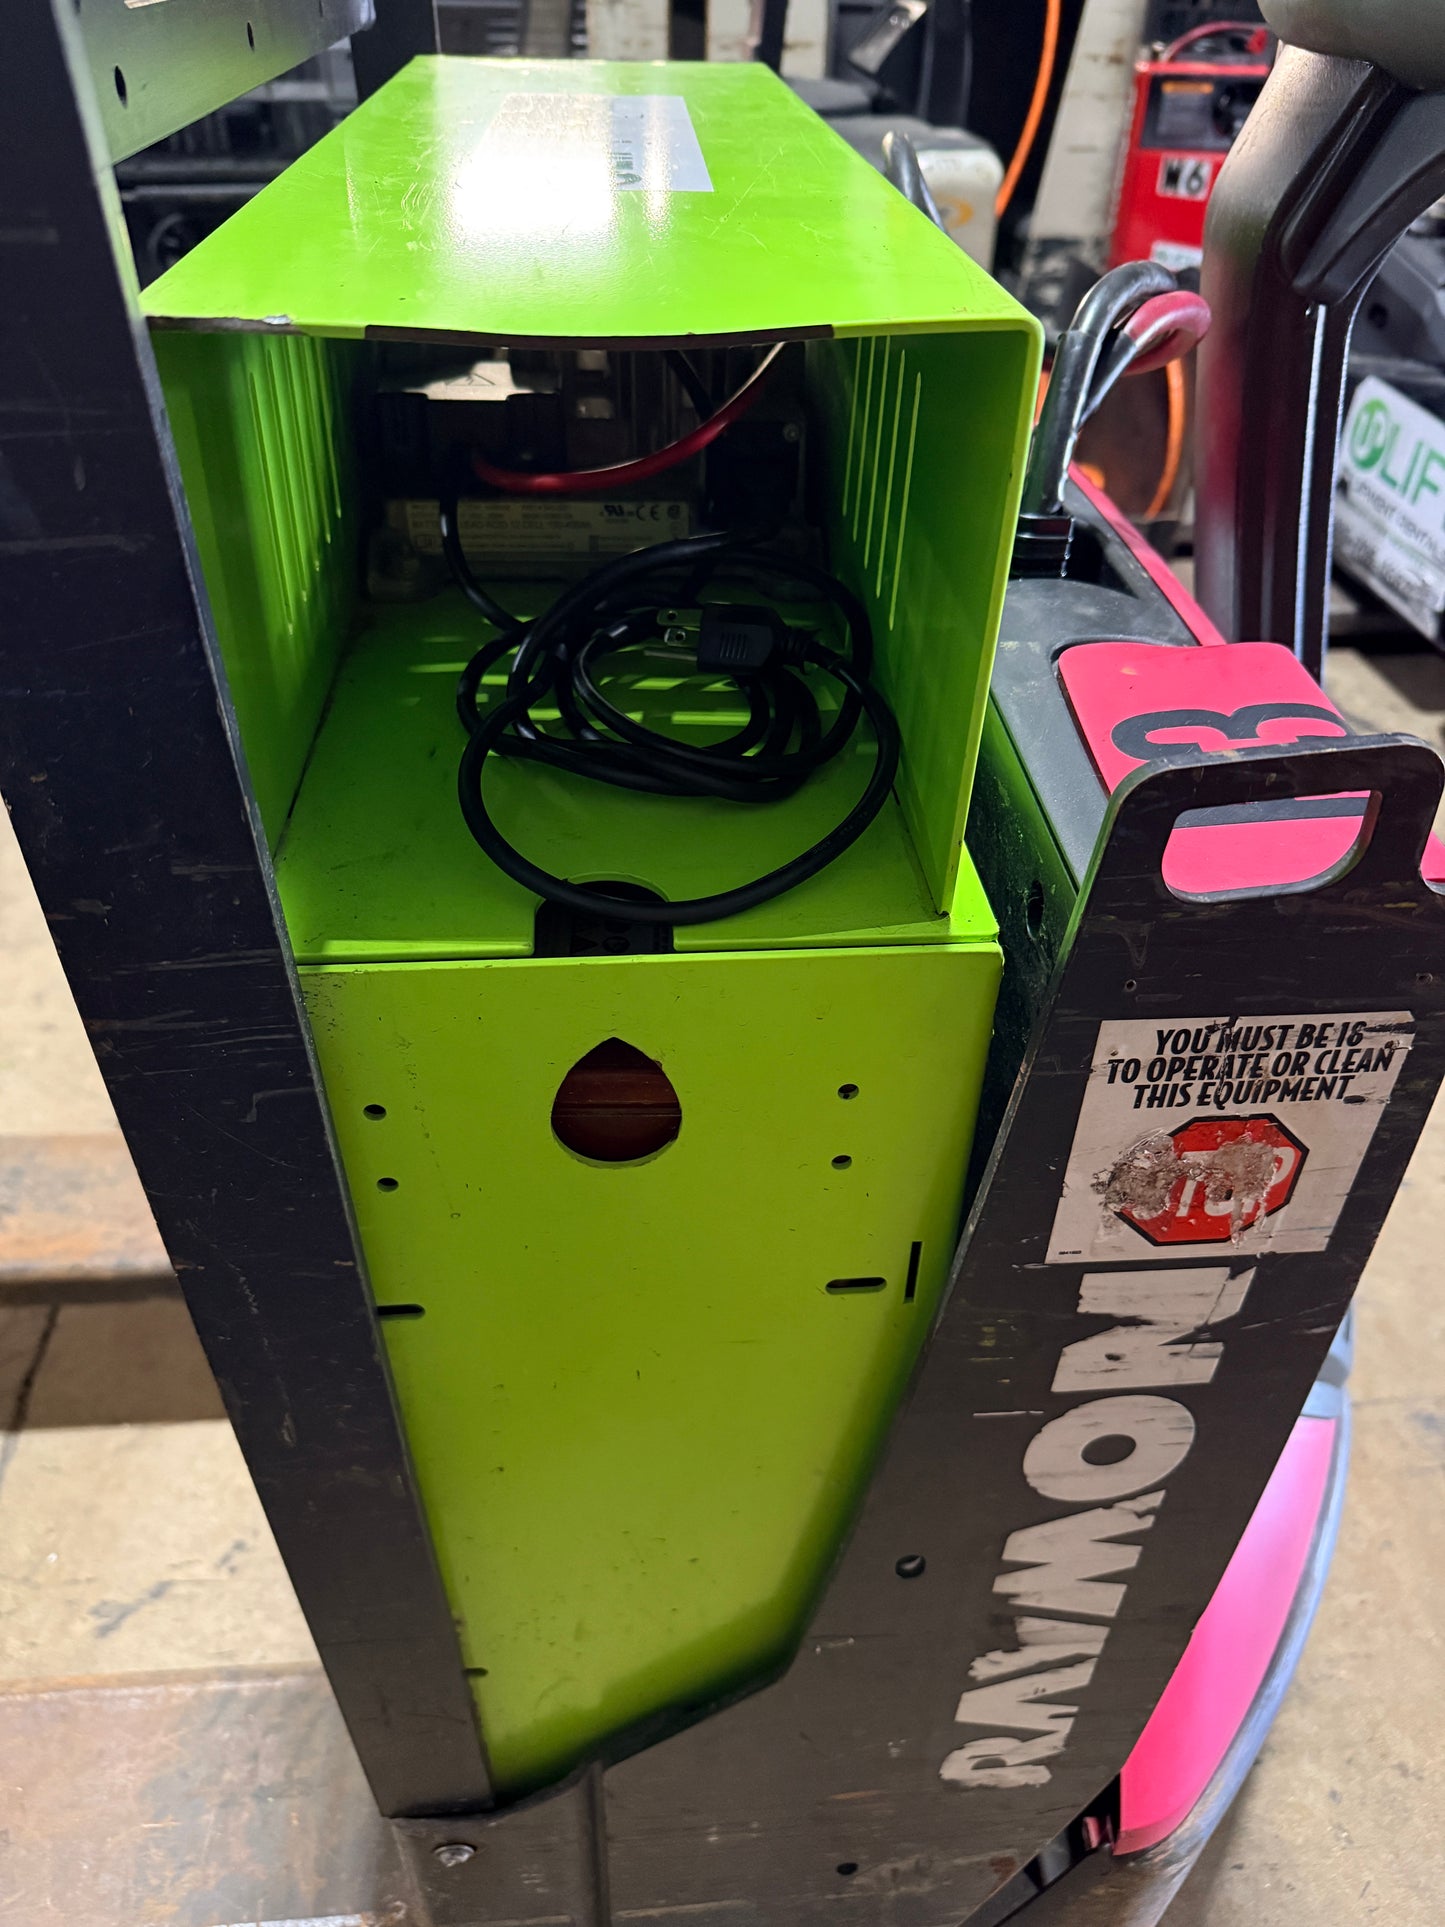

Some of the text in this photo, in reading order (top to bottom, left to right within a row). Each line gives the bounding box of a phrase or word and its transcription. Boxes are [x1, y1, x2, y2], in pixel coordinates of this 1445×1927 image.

[1156, 1027, 1211, 1055] YOU
[1216, 1024, 1295, 1053] MUST
[1295, 1022, 1334, 1048] BE
[1107, 1047, 1394, 1084] TO OPERATE OR CLEAN
[1133, 1075, 1354, 1110] THIS EQUIPMENT
